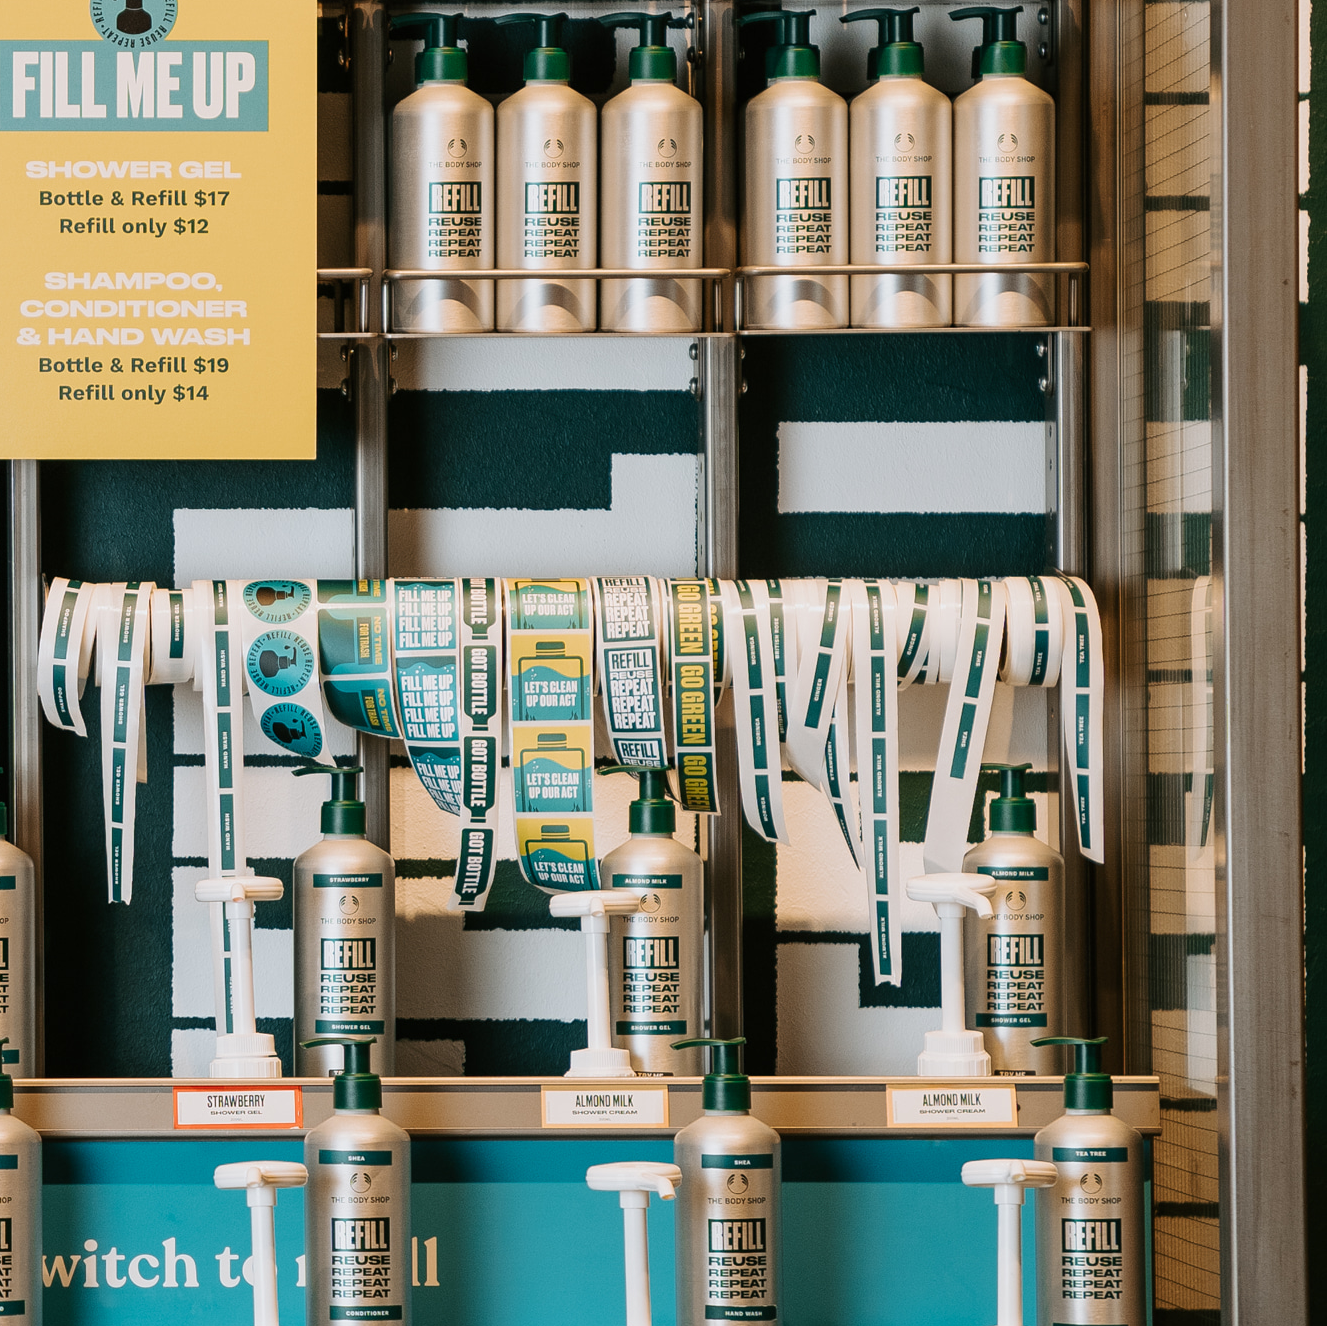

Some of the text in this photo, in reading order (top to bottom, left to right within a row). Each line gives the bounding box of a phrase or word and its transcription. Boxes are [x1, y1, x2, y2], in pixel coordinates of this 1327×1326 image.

[12, 52, 256, 119] FILL ME UP
[25, 160, 242, 179] SHOWER GEL
[39, 189, 230, 208] Bottle & Refill $17
[60, 217, 209, 238] Refill only $12
[44, 271, 223, 292] SHAMPOO,
[20, 299, 247, 318] CONDITIONER
[16, 327, 251, 346] & HAND WASH
[39, 356, 229, 375] Bottle & Refill $19
[59, 383, 210, 405] Refill only $14
[374, 616, 383, 665] NO TIME
[471, 648, 489, 716] GOT BOTTLE
[524, 680, 578, 694] LET'S CLEAN
[526, 694, 577, 707] UP OUR ACT
[680, 664, 707, 744] GO GREEN
[575, 1094, 634, 1108] ALMOND MILK
[42, 1237, 200, 1288] witch
